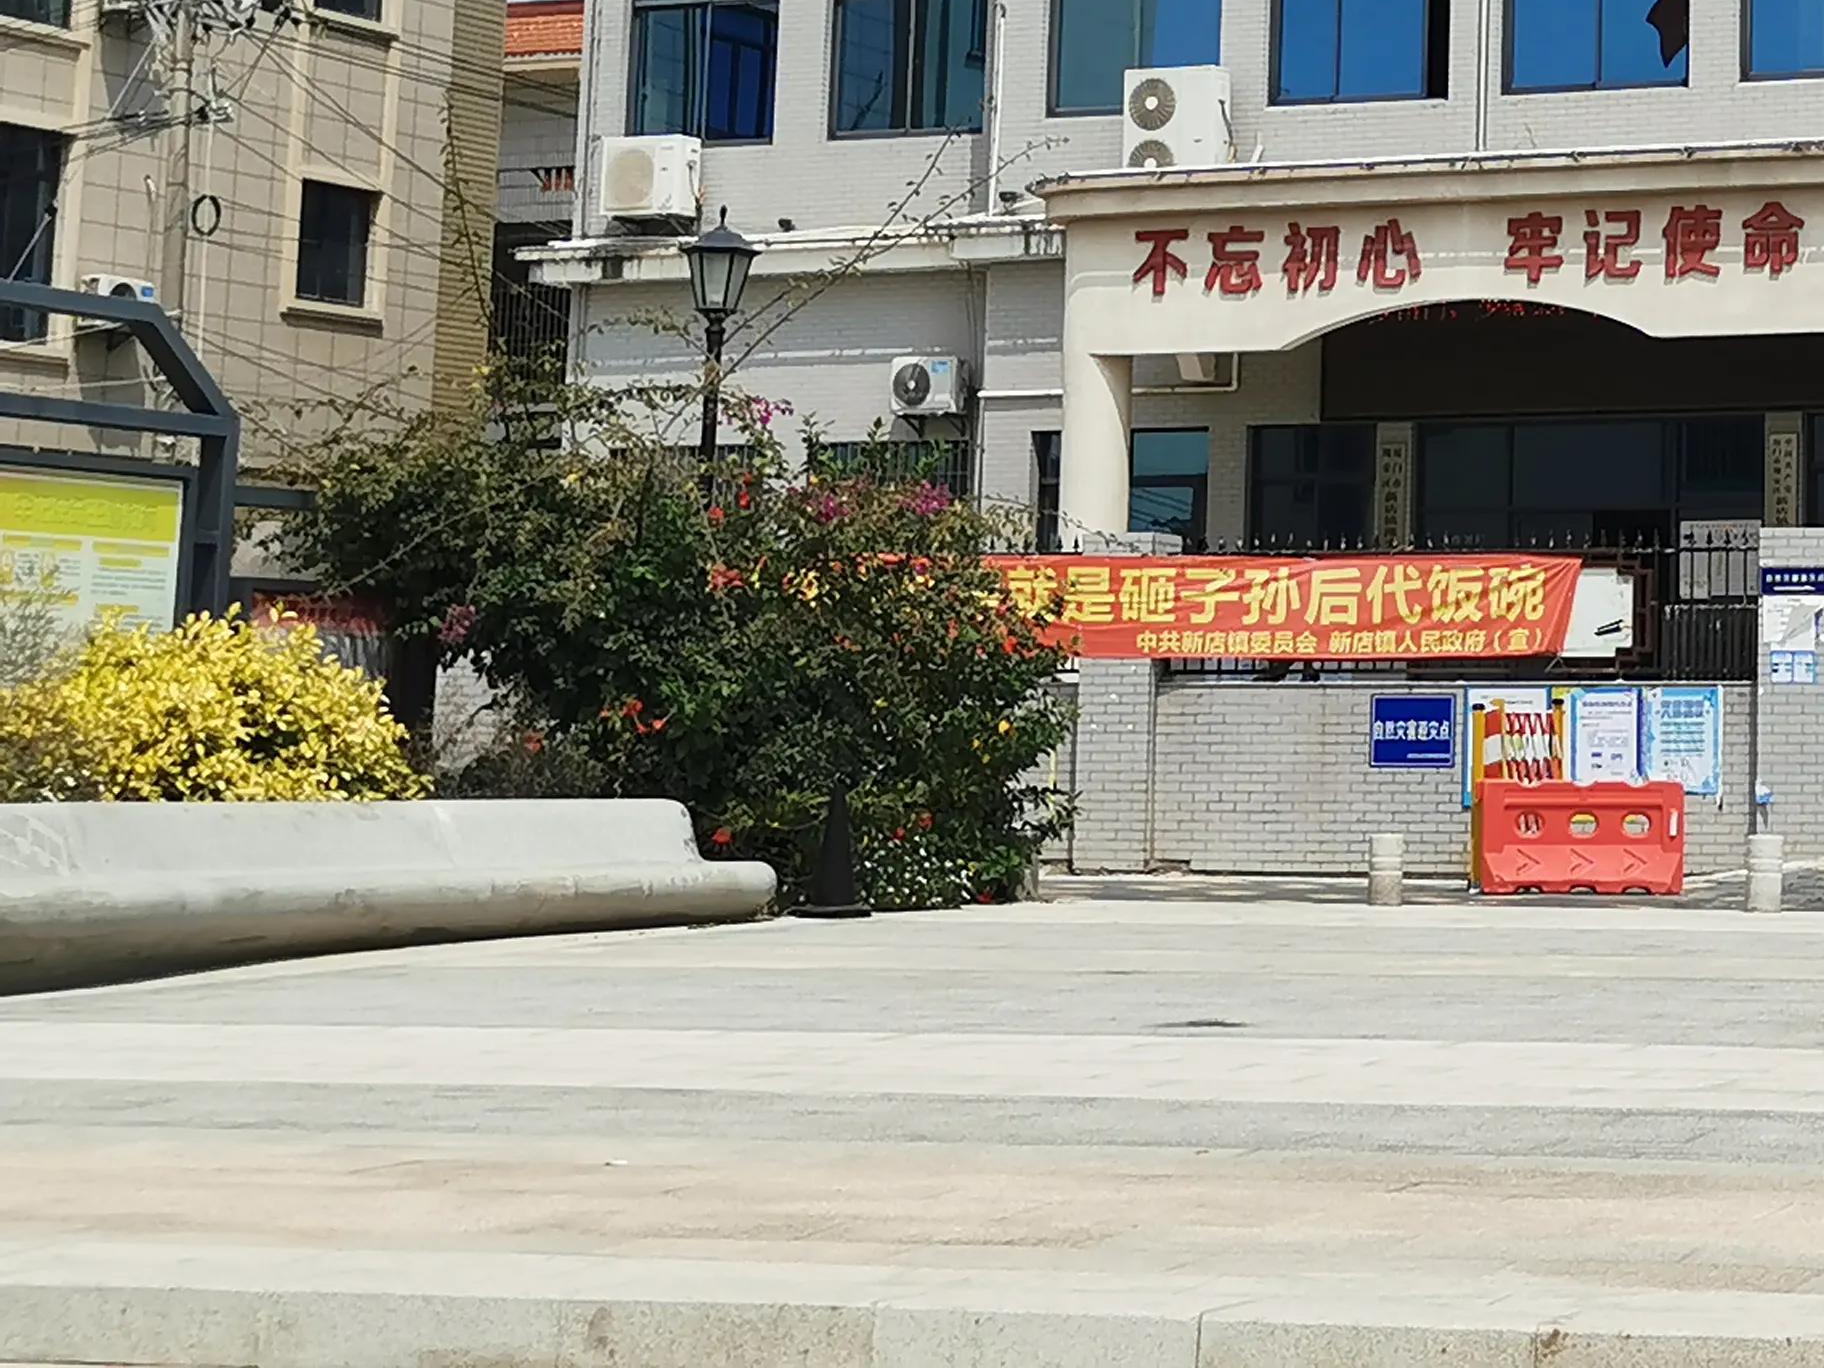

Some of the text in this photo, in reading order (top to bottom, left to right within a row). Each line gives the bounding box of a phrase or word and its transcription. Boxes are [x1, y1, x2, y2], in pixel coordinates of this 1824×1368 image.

[1132, 201, 1805, 297] 不忘初心 牢记使命
[1136, 630, 1317, 654] 中共新店镇委员会
